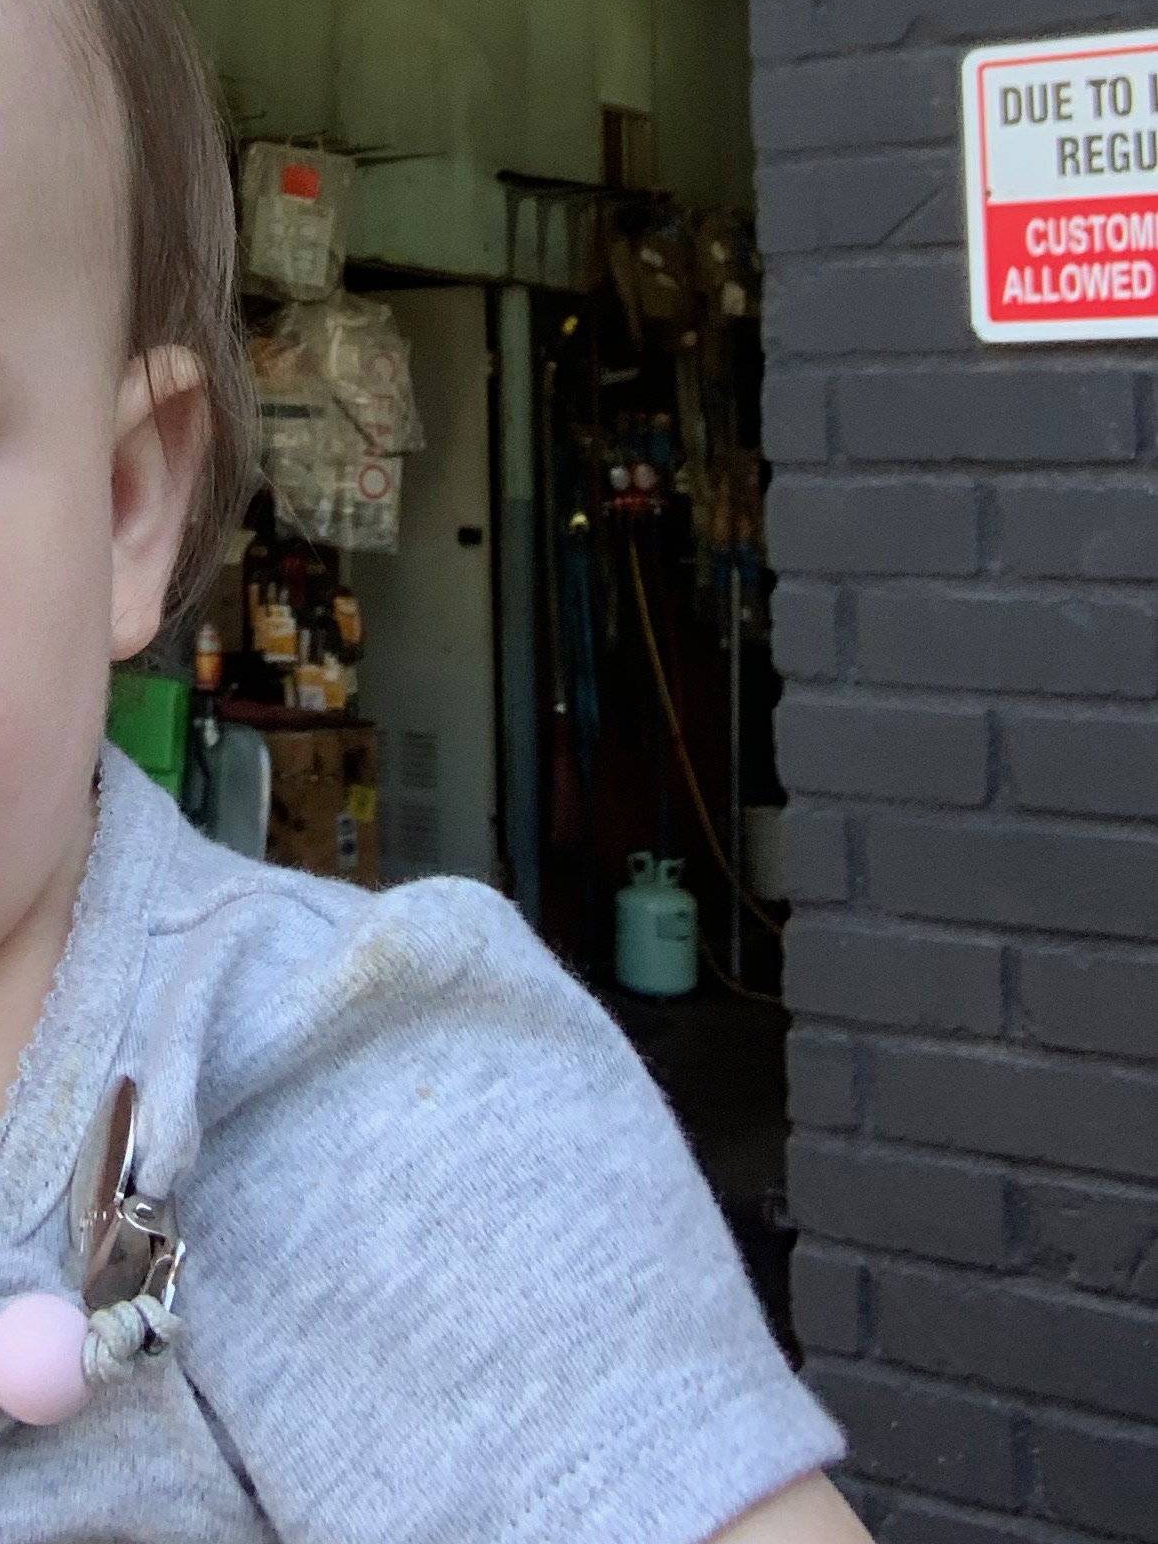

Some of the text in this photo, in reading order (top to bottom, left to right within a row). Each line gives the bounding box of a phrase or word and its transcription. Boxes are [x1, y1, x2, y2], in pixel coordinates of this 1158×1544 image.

[999, 81, 1074, 126] DUE
[1086, 75, 1133, 119] TO
[1056, 129, 1158, 177] REGU
[1025, 211, 1158, 257] CUSTOM
[1002, 260, 1155, 305] ALLOWED
